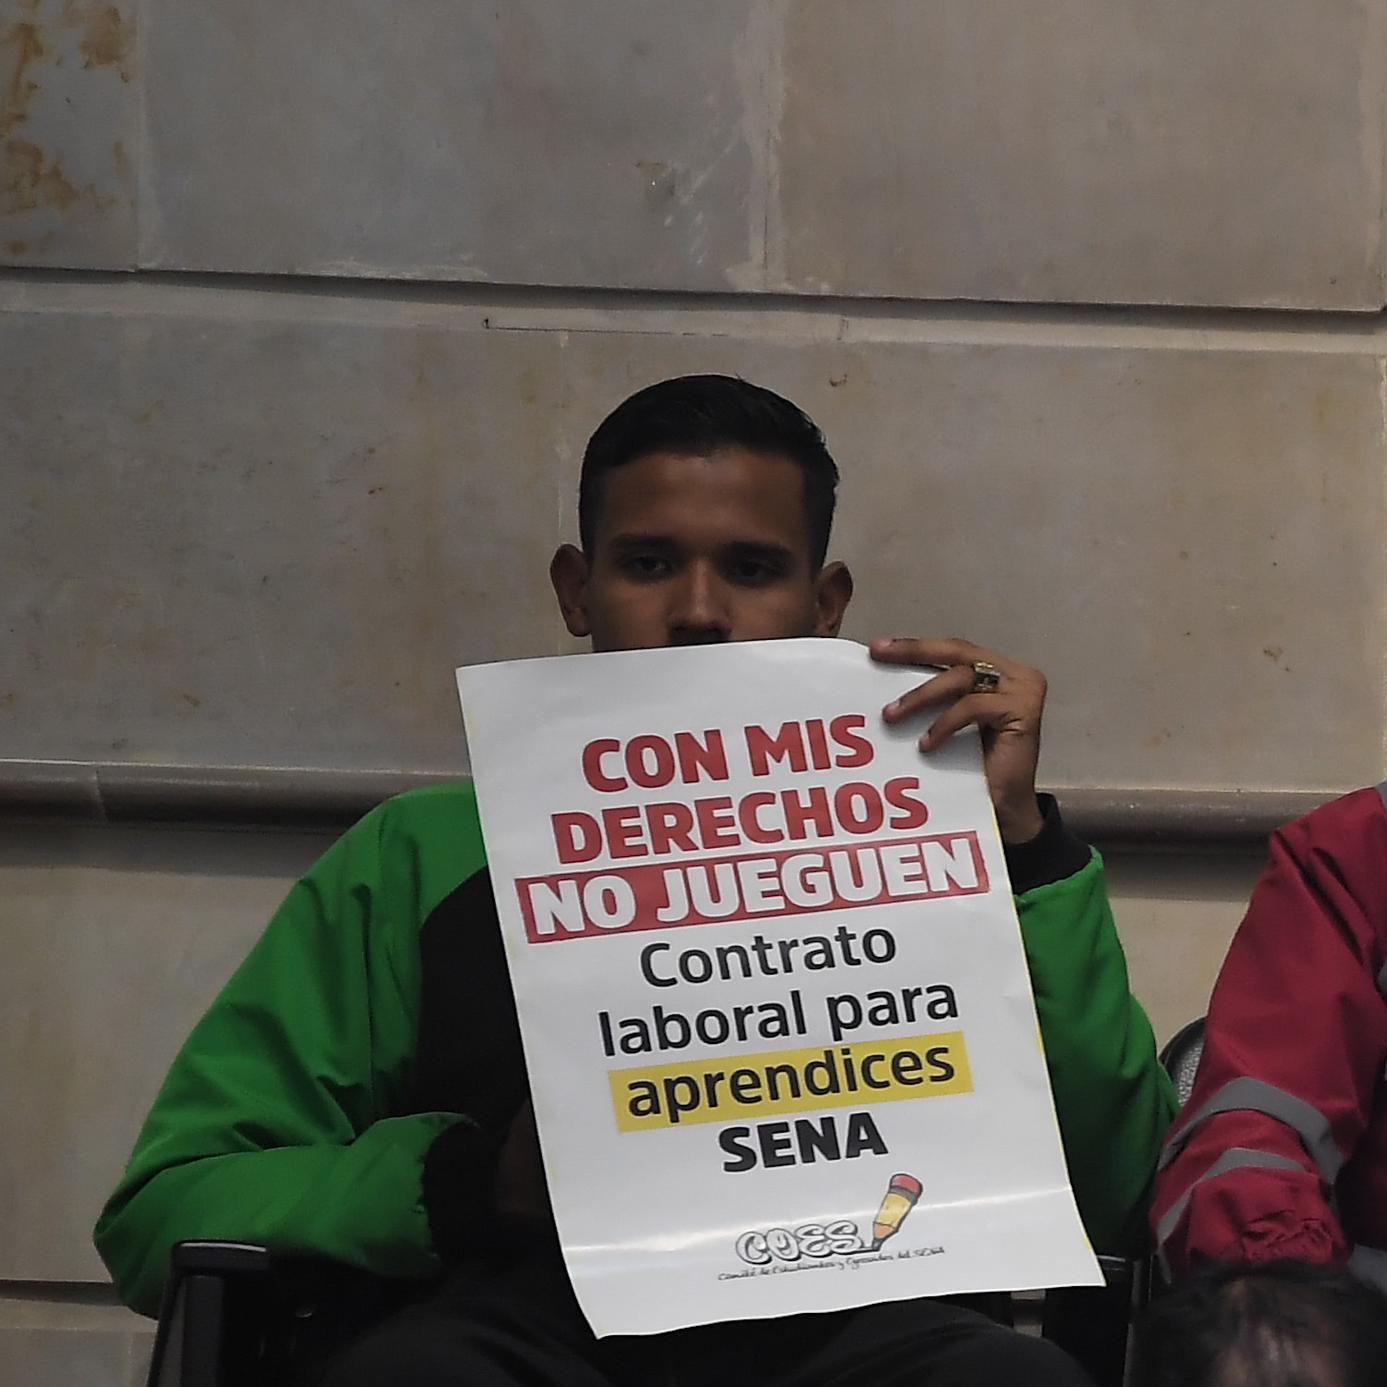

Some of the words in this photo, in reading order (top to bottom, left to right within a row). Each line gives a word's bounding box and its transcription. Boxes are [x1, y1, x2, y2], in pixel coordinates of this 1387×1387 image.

[585, 732, 728, 792] CON
[747, 717, 874, 775] MIS
[555, 779, 928, 864] DERECHOS
[529, 876, 635, 934] NO
[658, 838, 978, 921] JUEGUEN
[641, 927, 895, 987] Contrato
[599, 990, 806, 1056] laboral
[827, 985, 958, 1041] para
[628, 1047, 954, 1123] aprendices
[719, 1112, 888, 1172] SENA
[735, 1220, 864, 1265] COES
